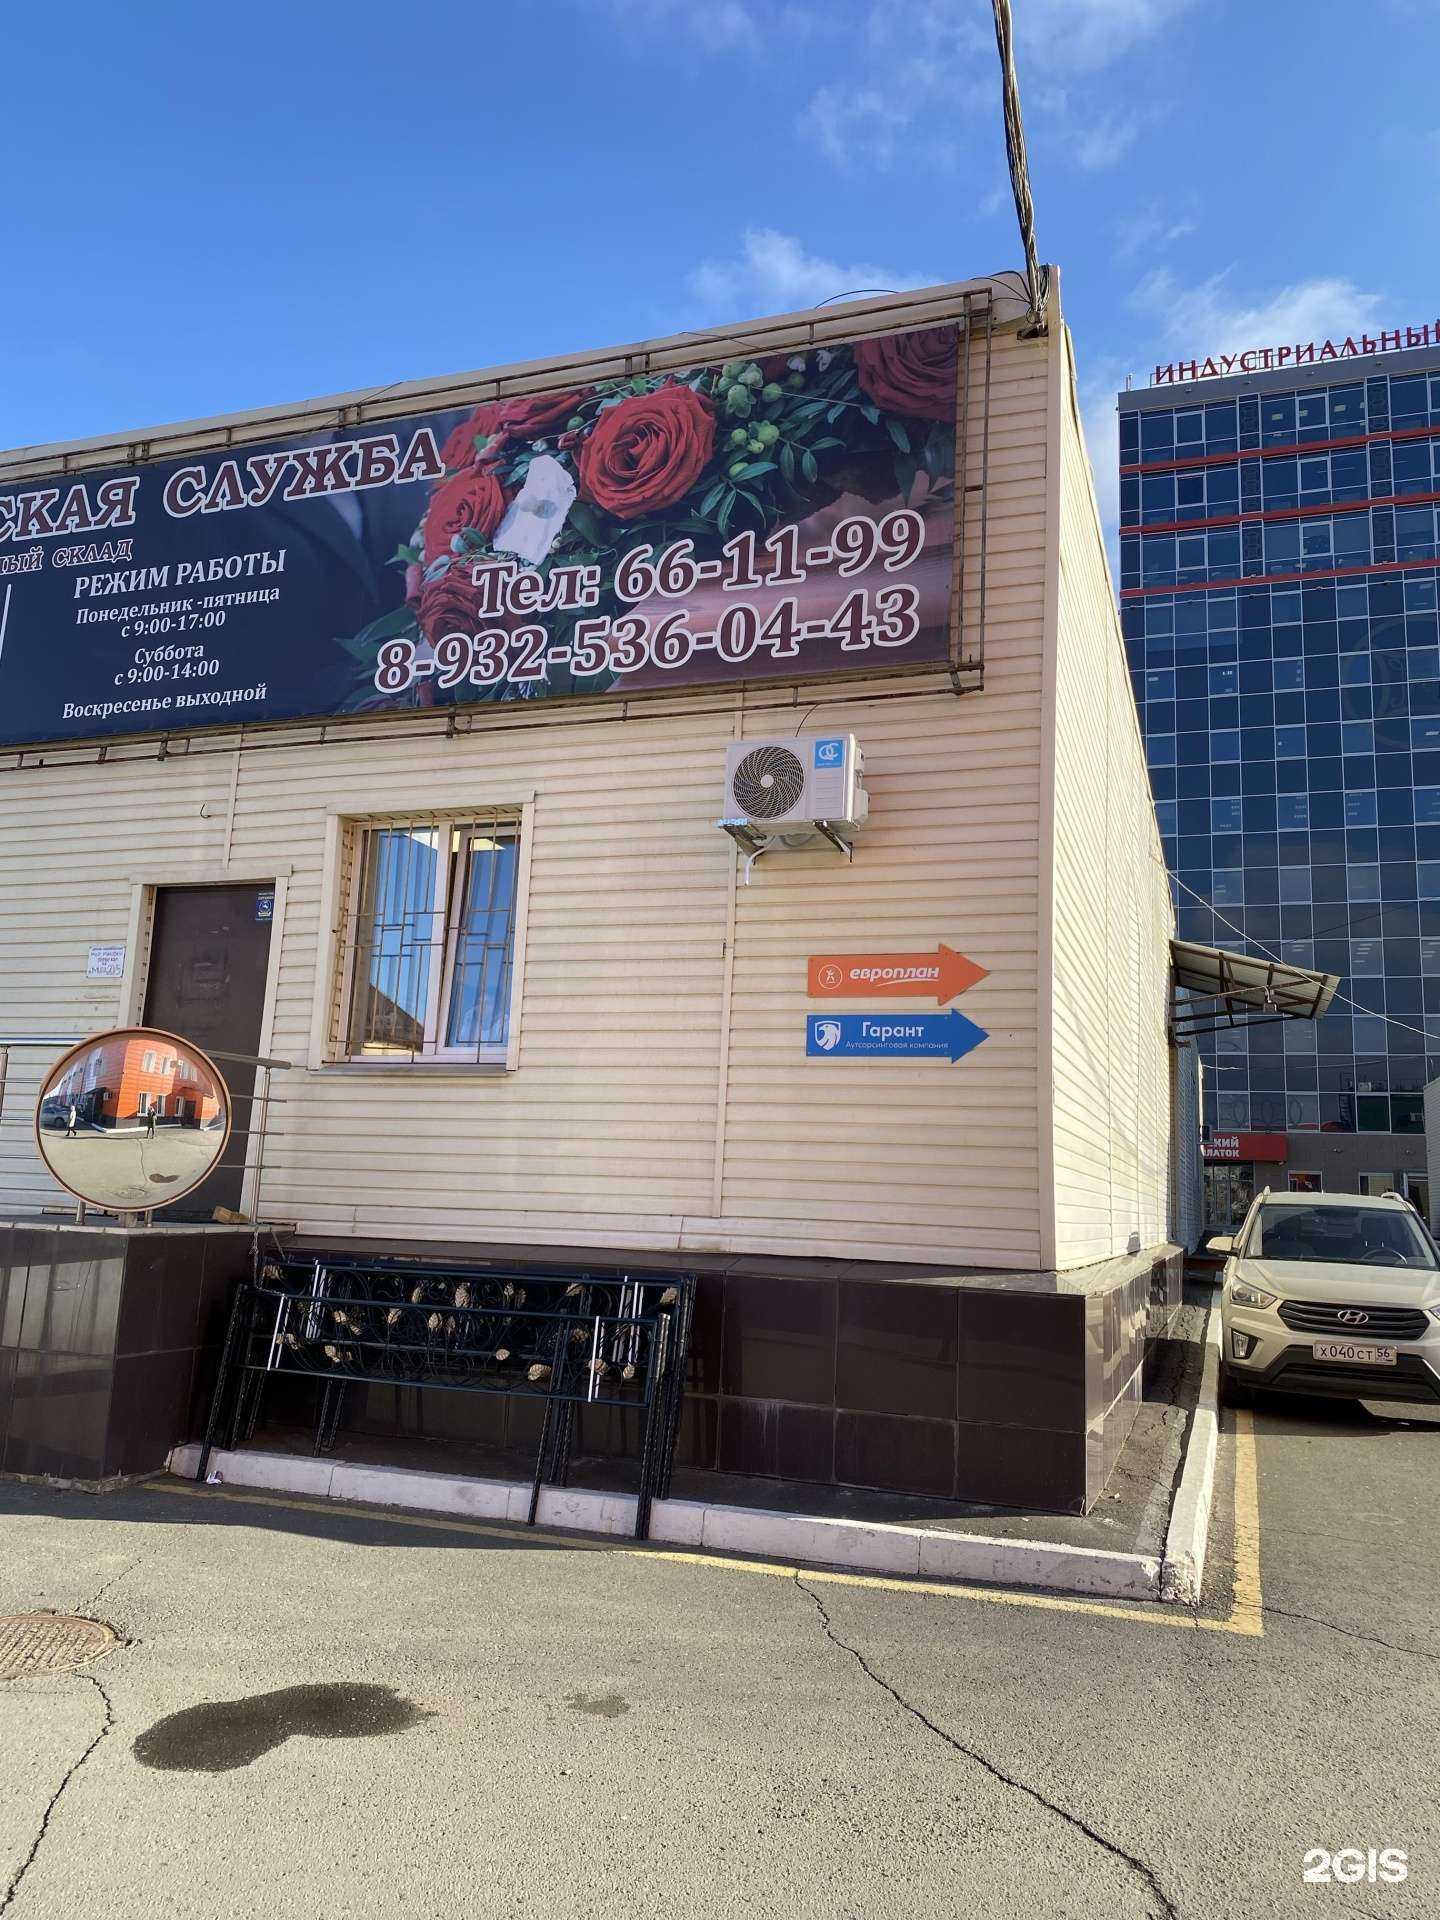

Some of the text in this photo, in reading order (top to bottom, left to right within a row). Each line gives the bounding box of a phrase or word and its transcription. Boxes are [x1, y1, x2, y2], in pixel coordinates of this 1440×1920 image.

[163, 427, 446, 518] СЛУЖБА
[52, 538, 134, 568] СКЛАД
[471, 509, 925, 619] Тел: 66-11-99
[73, 549, 287, 599] РЕЖИМ РАБОТЫ
[76, 597, 194, 625] Понедельник
[121, 610, 226, 638] с 9:00-17:00
[373, 584, 920, 694] 8-932-536-04-43
[134, 644, 205, 668] Суббота
[114, 659, 220, 686] с 9:00-14:00
[62, 682, 268, 719] Воскресенье выходной
[850, 967, 939, 982] европлан
[862, 1021, 924, 1042] Гарант
[909, 1041, 949, 1050] компания
[1208, 1135, 1240, 1148] КИЙ
